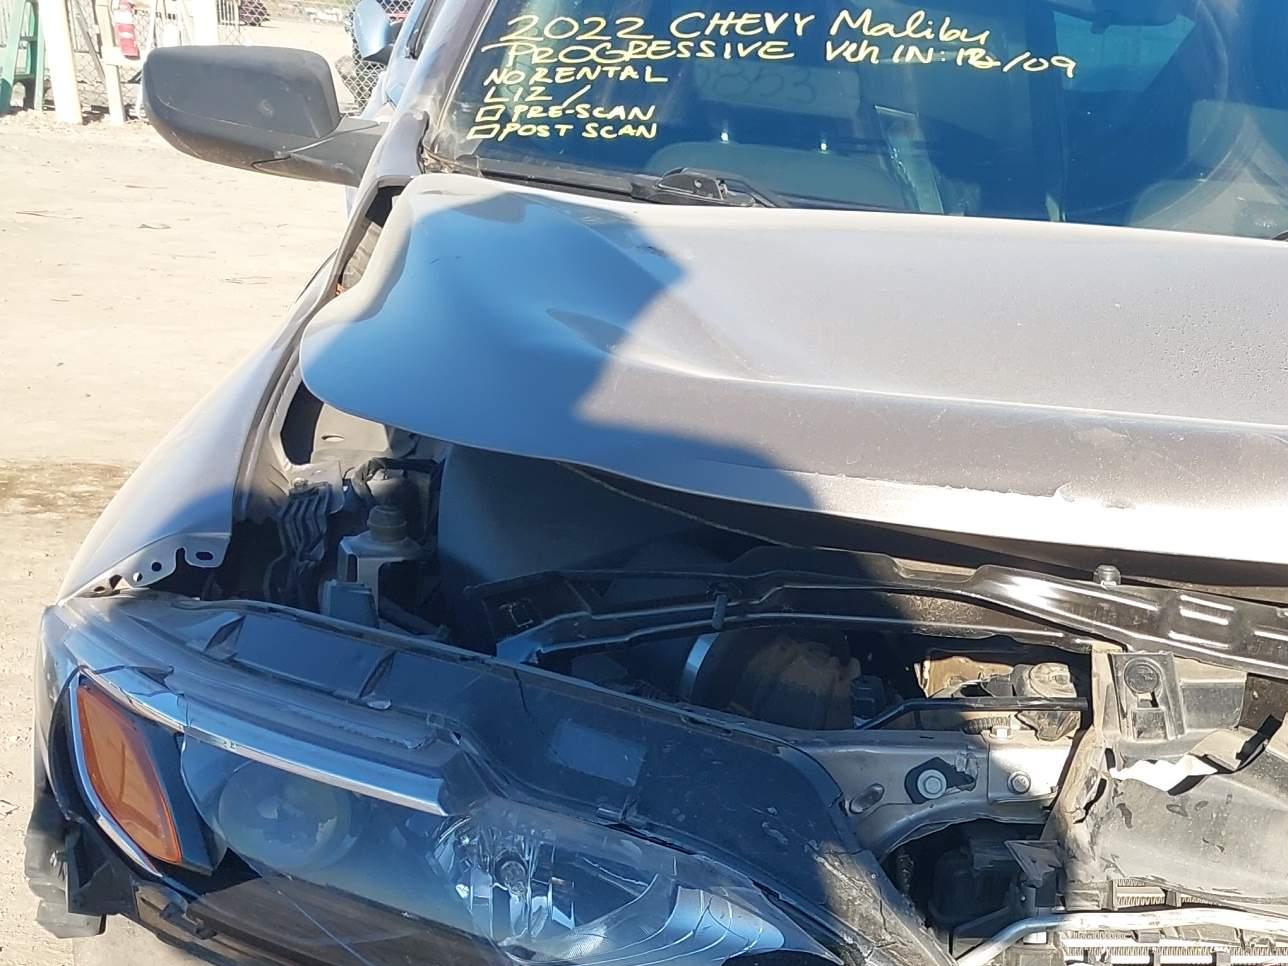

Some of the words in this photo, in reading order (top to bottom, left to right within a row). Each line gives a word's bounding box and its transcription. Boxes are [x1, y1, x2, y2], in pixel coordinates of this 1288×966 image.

[499, 15, 655, 42] 2022
[669, 12, 816, 39] CHEVY
[830, 8, 990, 45] Malibu
[480, 39, 796, 67] PROGRESSIVE
[892, 45, 946, 64] IN:
[483, 67, 526, 86] NO
[528, 65, 669, 85] RENTAL
[511, 103, 656, 122] PRE-SCAN
[498, 123, 574, 141] POST
[581, 122, 658, 139] SCAN
